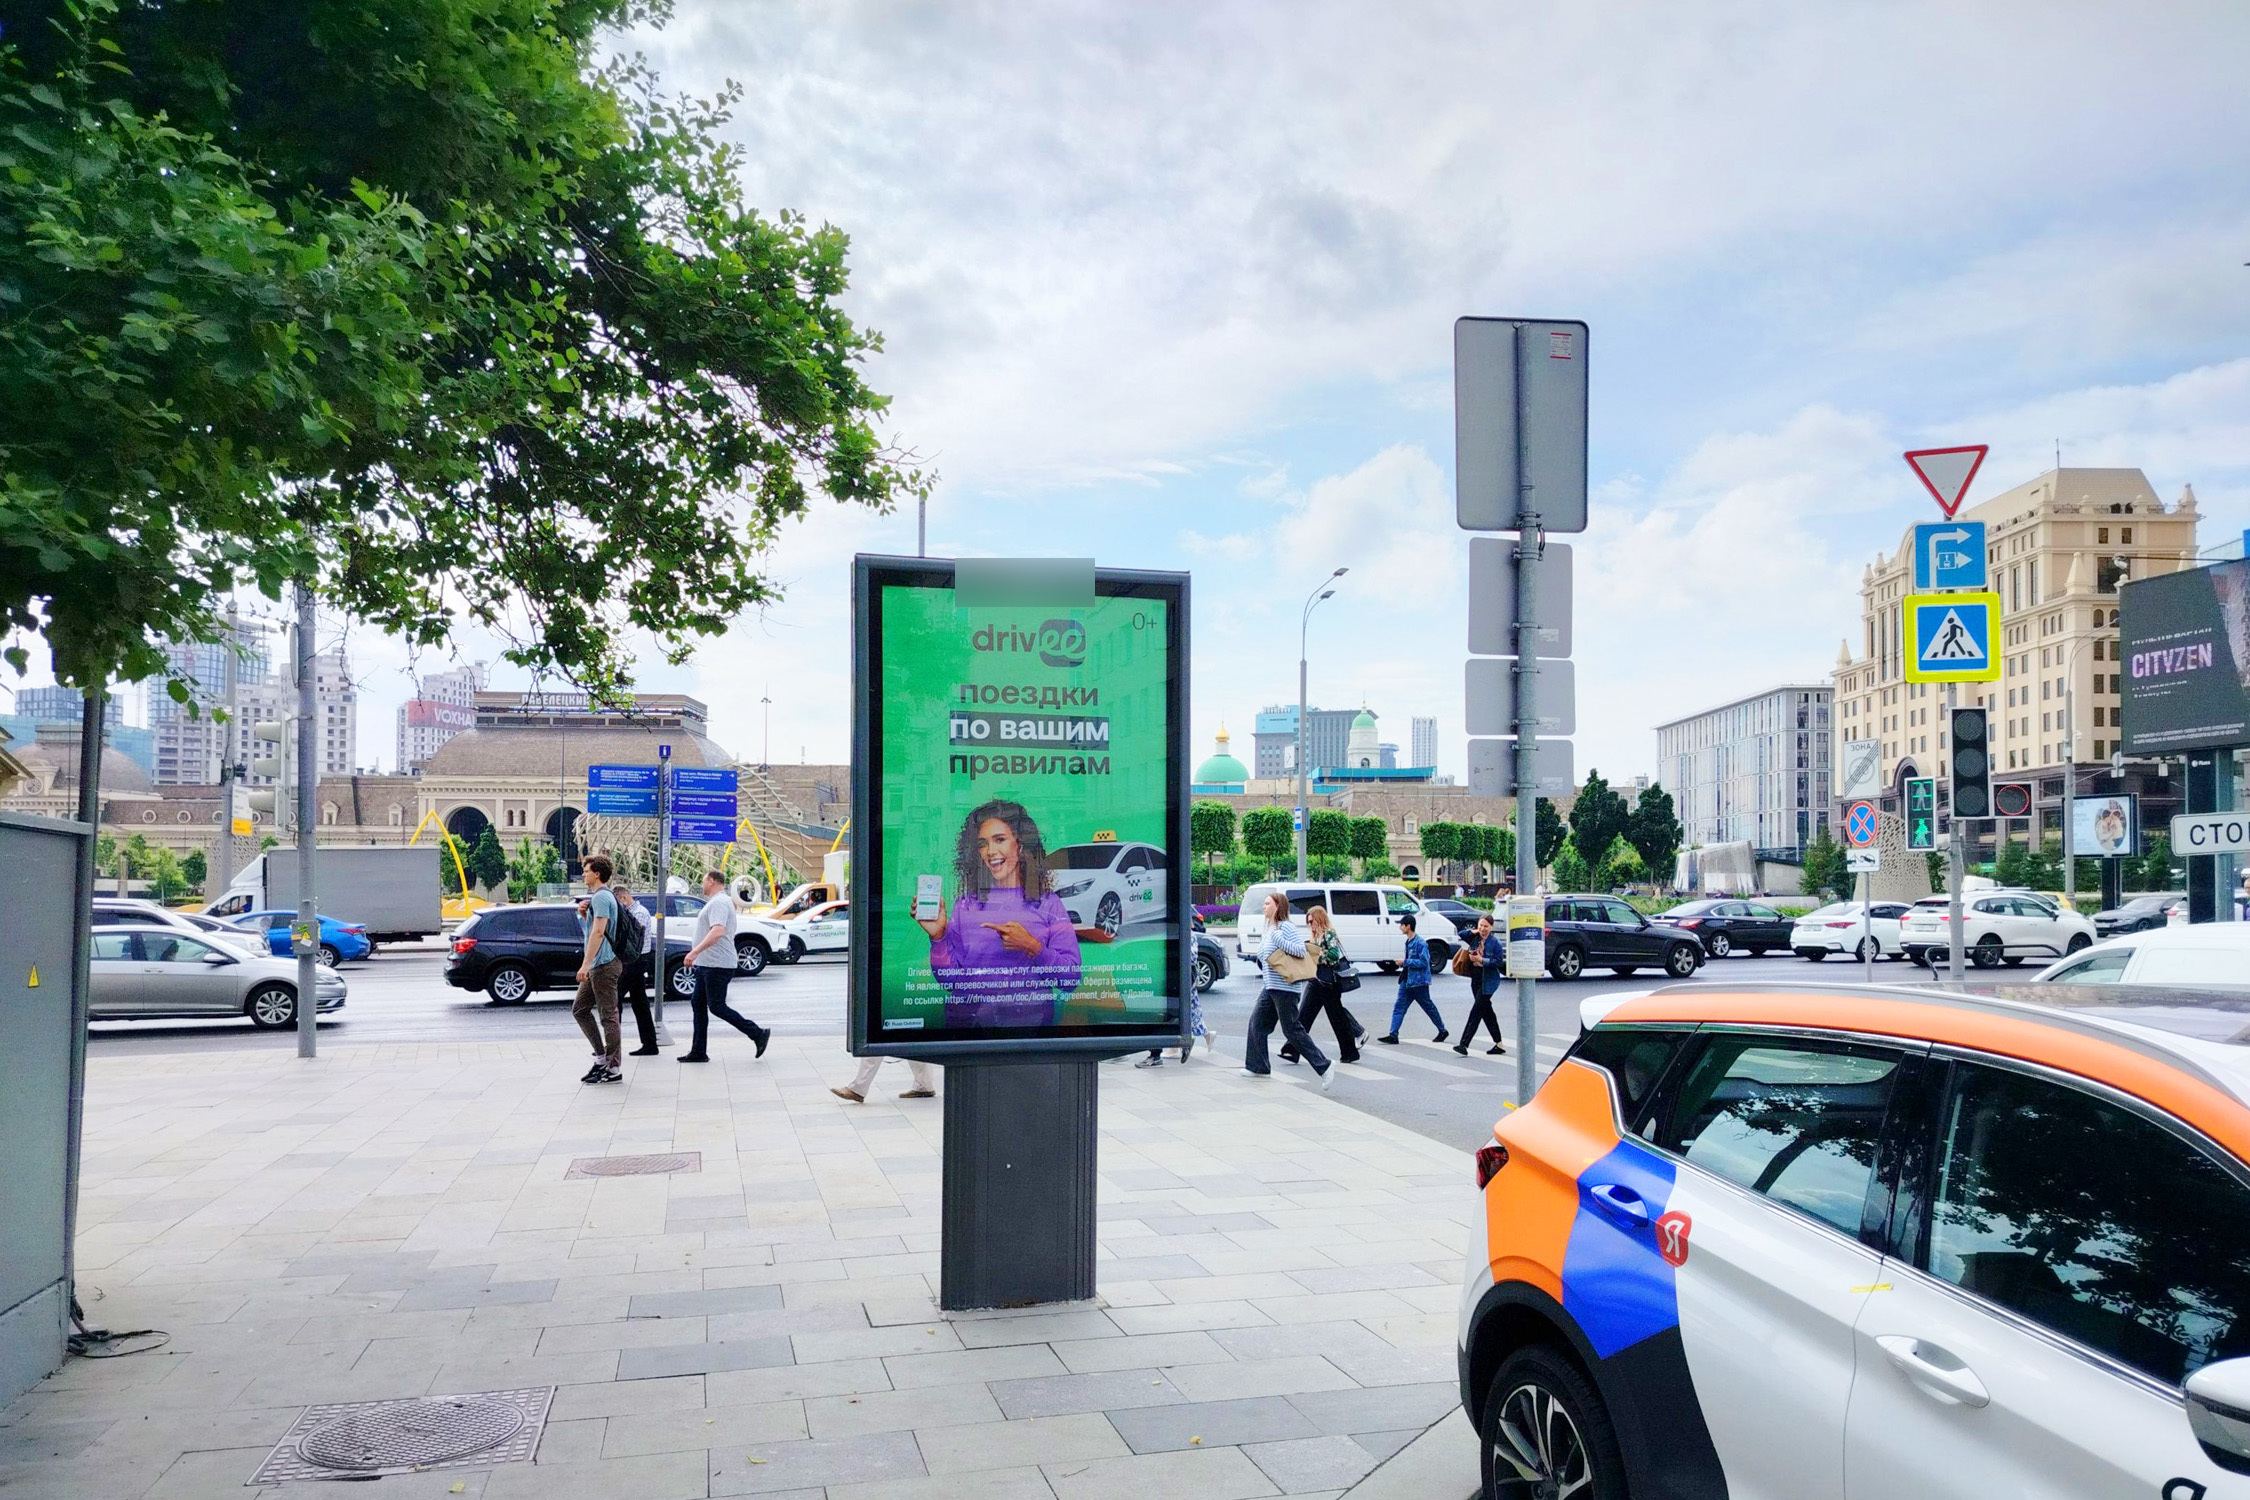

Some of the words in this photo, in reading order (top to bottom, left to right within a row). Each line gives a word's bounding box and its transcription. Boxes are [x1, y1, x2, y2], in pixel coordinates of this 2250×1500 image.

[1132, 612, 1157, 631] 0+
[972, 620, 1086, 664] drivee
[2131, 642, 2213, 678] CITYZEN
[960, 684, 1099, 710] поездки
[950, 718, 991, 739] по
[999, 719, 1109, 741] вашим
[1850, 743, 1871, 752] ЗОНА
[949, 753, 1110, 780] правилам
[2189, 821, 2250, 846] СТО
[907, 967, 931, 977] Drivee
[937, 968, 965, 978] сервис
[1009, 966, 1030, 976] услуг
[1031, 965, 1070, 975] перевозки
[1071, 964, 1115, 973] пассажиров
[1122, 962, 1149, 971] багажа.
[905, 982, 916, 991] Не
[916, 982, 954, 991] является
[954, 981, 1009, 991] перевозчиком
[1010, 980, 1025, 989] или
[1025, 978, 1058, 989] службой
[1083, 977, 1110, 987] Оферта
[1111, 976, 1152, 986] размещена
[903, 997, 913, 1006] по
[914, 997, 944, 1006] ссылке
